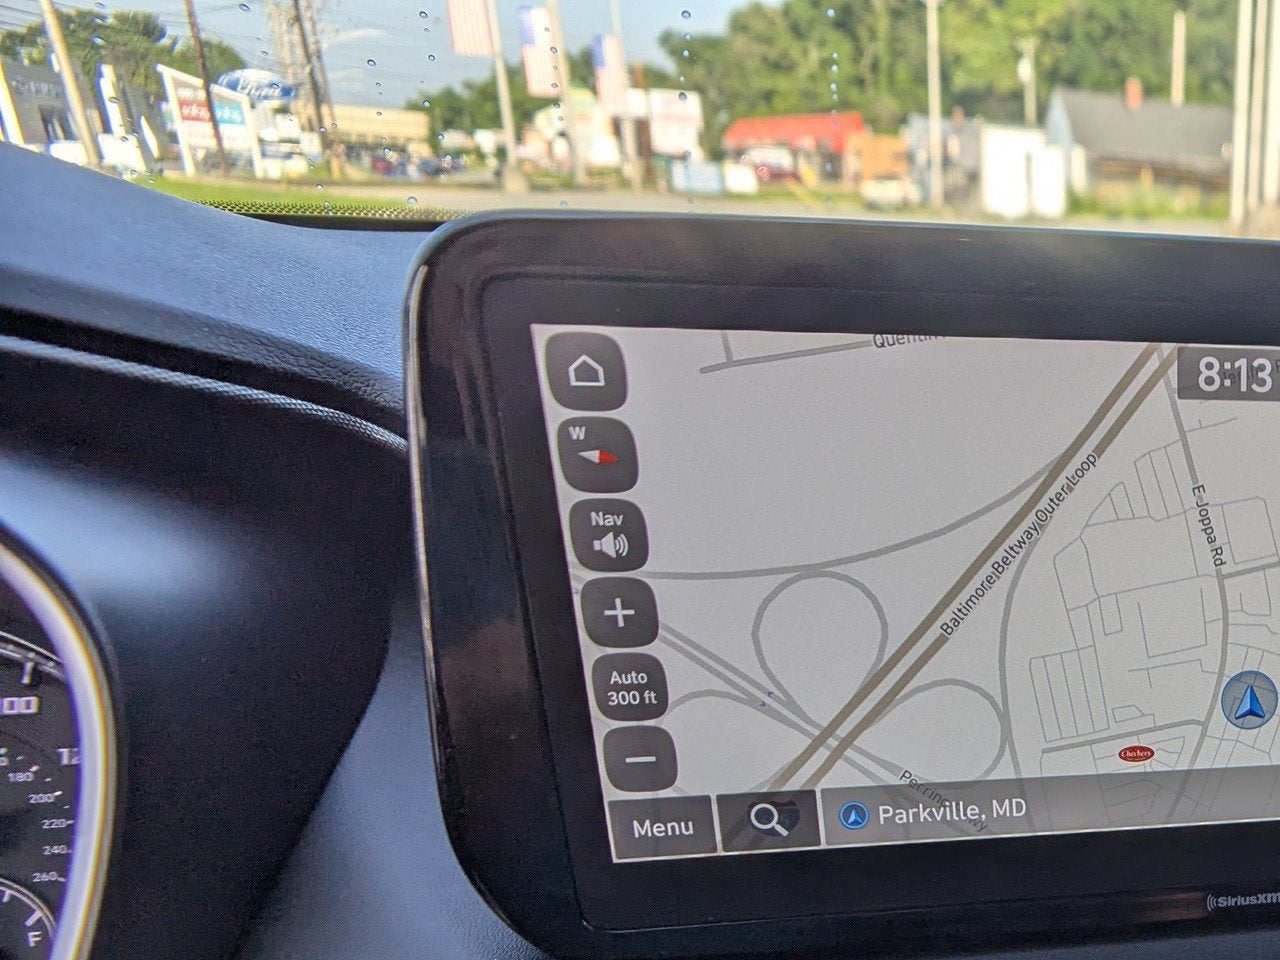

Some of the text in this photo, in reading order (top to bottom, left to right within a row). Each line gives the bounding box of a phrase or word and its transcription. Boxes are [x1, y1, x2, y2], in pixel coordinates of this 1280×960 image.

[1198, 356, 1273, 393] 8:13
[568, 426, 586, 440] W
[590, 511, 624, 527] Nav
[1192, 484, 1227, 568] E Joppa Rd
[940, 451, 1100, 637] Baltimore Beltway Outer Loop
[610, 670, 648, 686] Auto
[0, 696, 39, 715] 00
[607, 690, 658, 706] 300 ft
[28, 792, 54, 804] 200
[877, 797, 1027, 826] Parkville, MD
[42, 818, 68, 829] 220
[632, 817, 694, 840] Menu
[42, 844, 68, 855] 240
[28, 931, 42, 947] F
